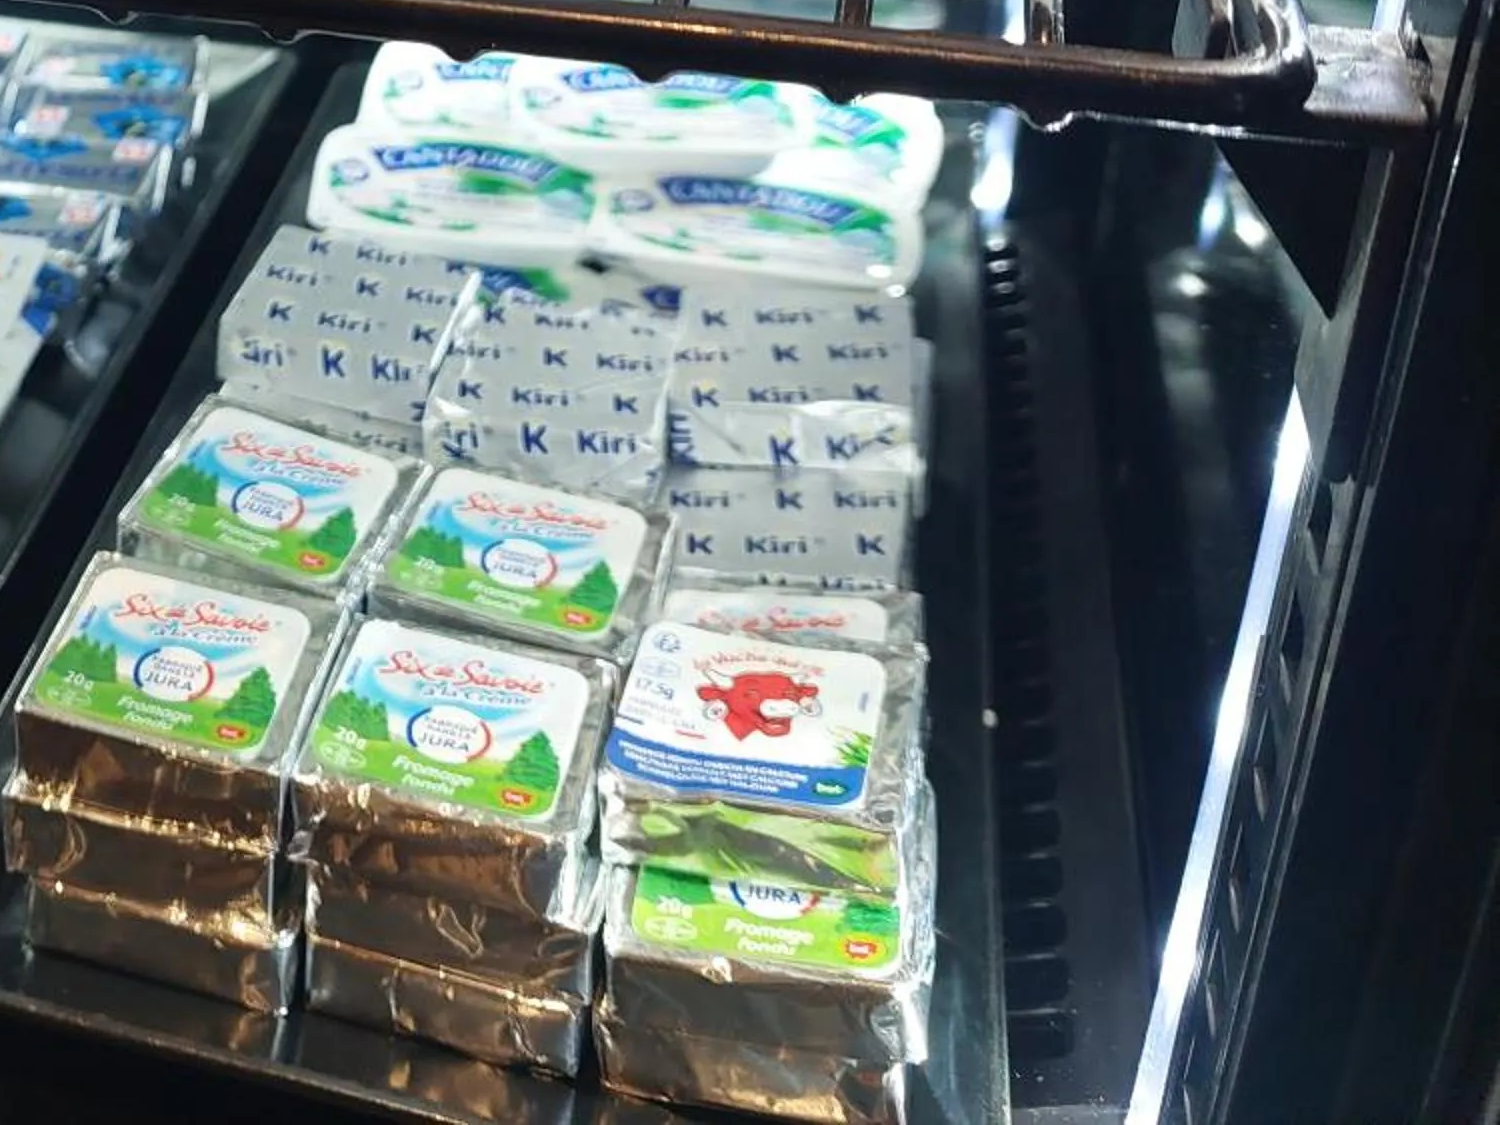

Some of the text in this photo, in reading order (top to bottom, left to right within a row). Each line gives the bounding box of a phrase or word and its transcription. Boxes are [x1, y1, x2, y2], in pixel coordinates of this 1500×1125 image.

[356, 244, 407, 266] Kiri
[267, 264, 319, 286] Kiri
[318, 312, 372, 333] Kiri
[754, 307, 814, 326] Kiri
[320, 345, 346, 378] K
[596, 351, 653, 372] Kiri
[673, 341, 889, 364] Kiri Kiri
[512, 386, 570, 407] Kiri
[691, 386, 809, 408] K Kiri
[520, 421, 637, 456] K Kiri
[768, 434, 799, 468] K
[240, 496, 285, 524] JURA
[669, 488, 898, 511] Kiri K Kiri
[686, 532, 886, 557] K Kiri K
[185, 601, 271, 632] Savoie
[64, 670, 94, 691] 20g
[144, 672, 194, 692] JURA
[453, 660, 547, 694] Savoie
[334, 726, 367, 751] 20g
[418, 735, 472, 753] JURA
[392, 754, 475, 787] Fromage
[746, 880, 802, 905] JURA
[656, 895, 694, 919] 20g
[724, 917, 815, 946] Fromage
[737, 935, 797, 956] fondu
